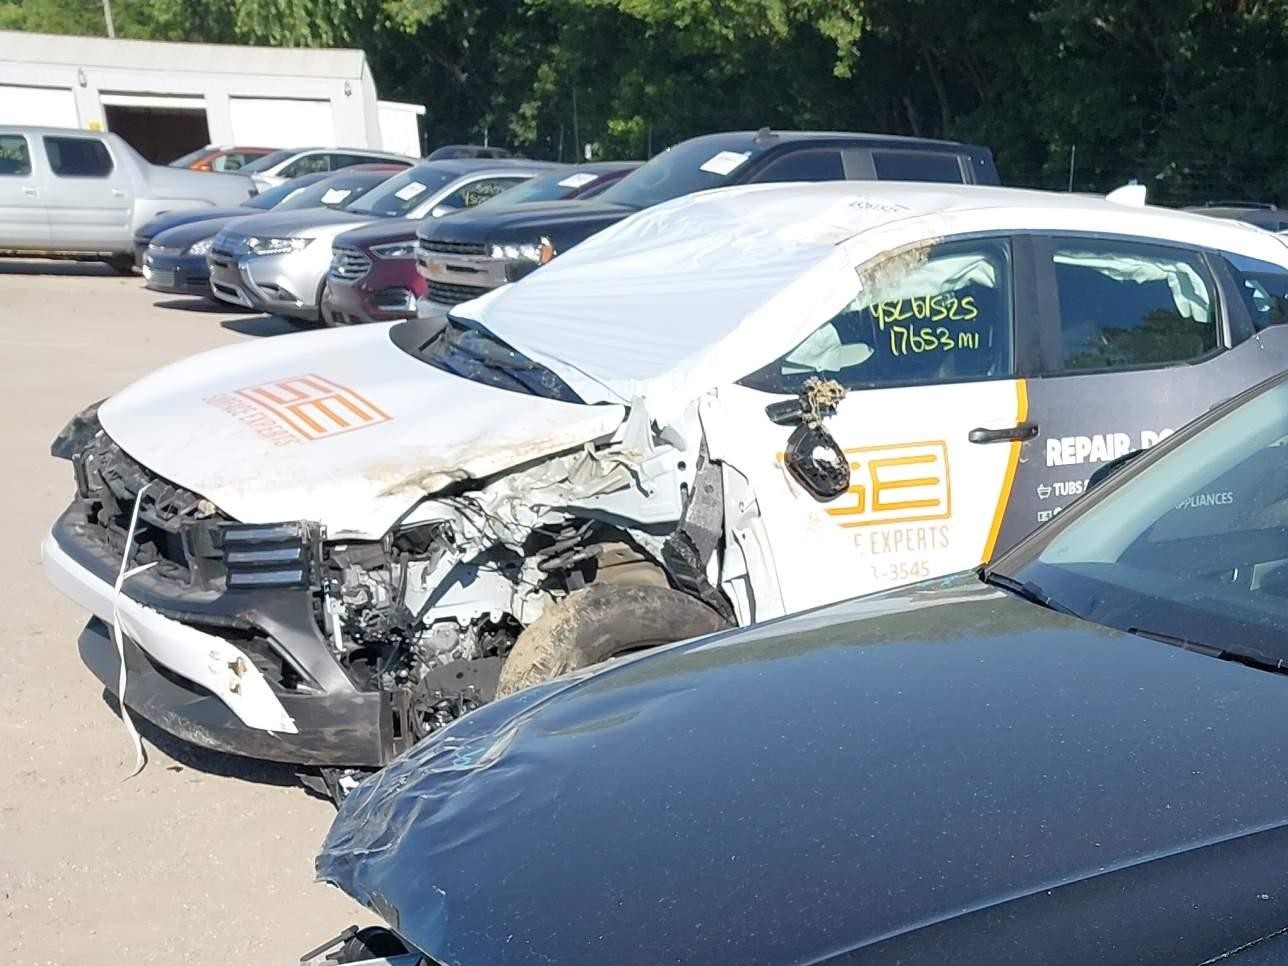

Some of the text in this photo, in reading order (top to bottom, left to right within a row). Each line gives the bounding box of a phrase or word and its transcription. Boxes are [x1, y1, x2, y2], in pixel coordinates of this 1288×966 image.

[890, 324, 954, 356] 17653
[1053, 480, 1083, 497] TUBS
[870, 526, 950, 555] EXPERTS
